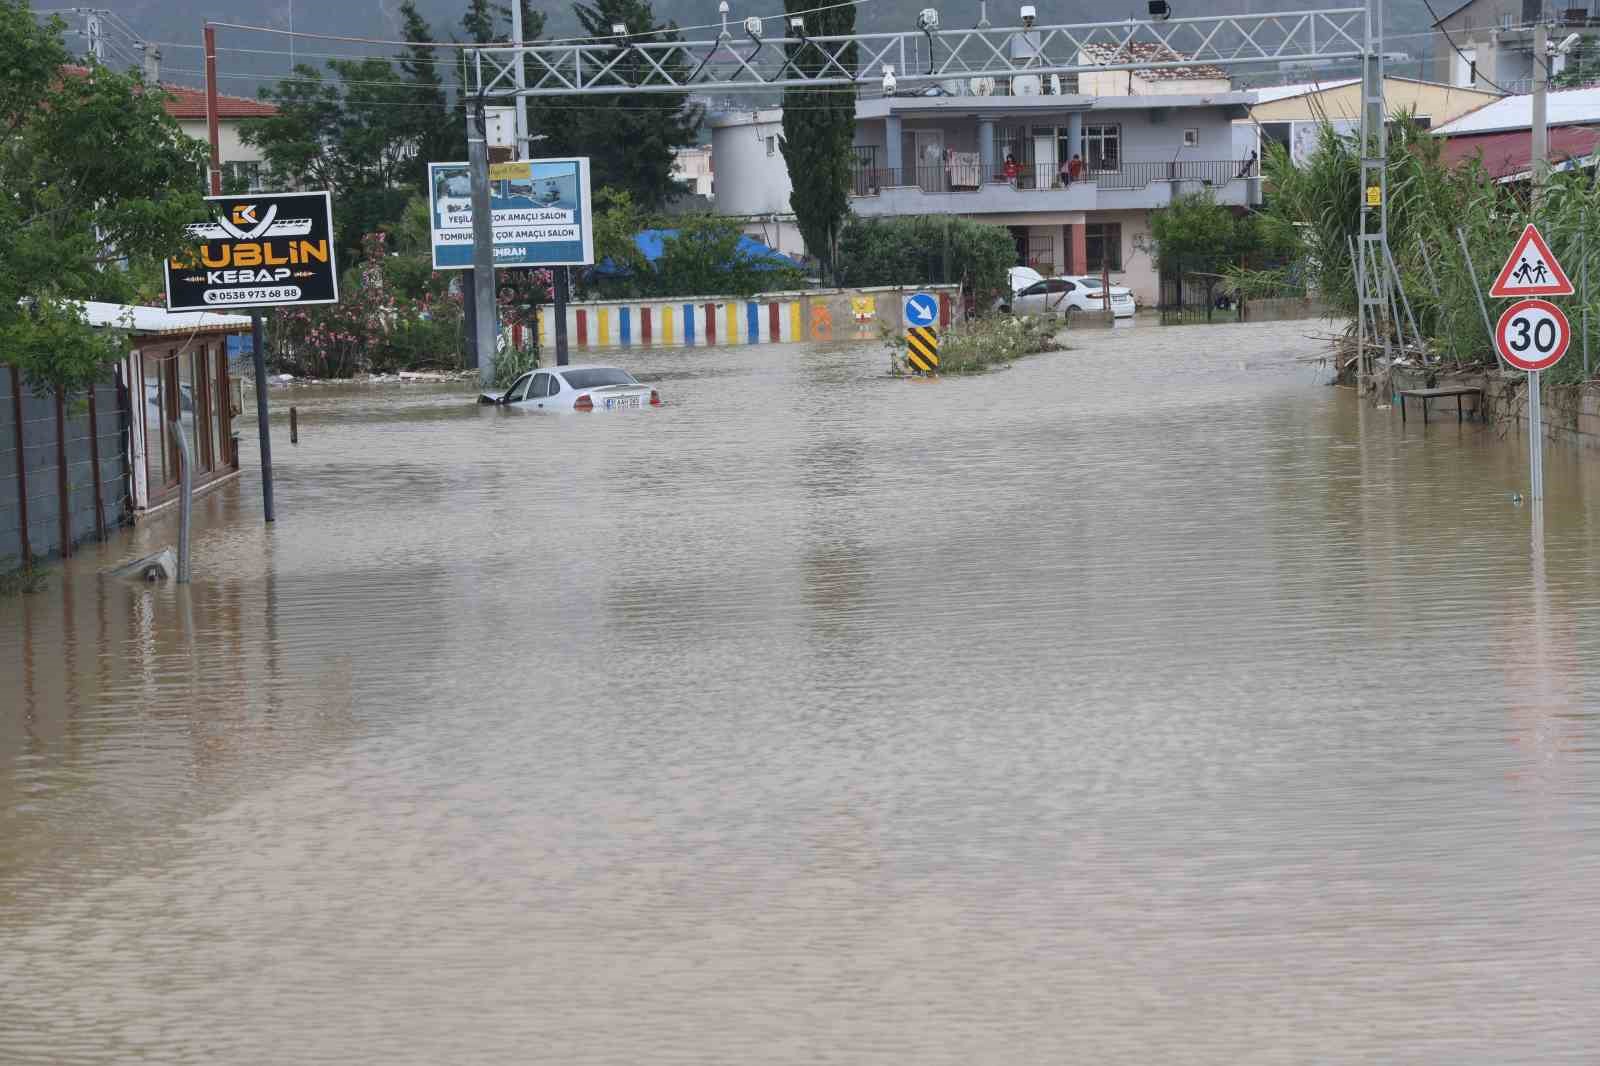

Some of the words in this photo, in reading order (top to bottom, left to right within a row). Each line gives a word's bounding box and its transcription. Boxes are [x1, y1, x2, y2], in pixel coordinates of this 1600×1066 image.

[508, 213, 538, 222] AMAÇLI
[540, 212, 567, 220] SALON
[495, 231, 514, 240] ÇOK
[515, 230, 546, 239] AMAÇLI
[547, 229, 575, 237] SALON
[207, 268, 291, 285] KEBAP
[219, 290, 246, 300] 0538
[247, 289, 266, 299] 973
[270, 289, 281, 298] 68
[284, 288, 297, 298] 88
[1510, 317, 1556, 353] 30
